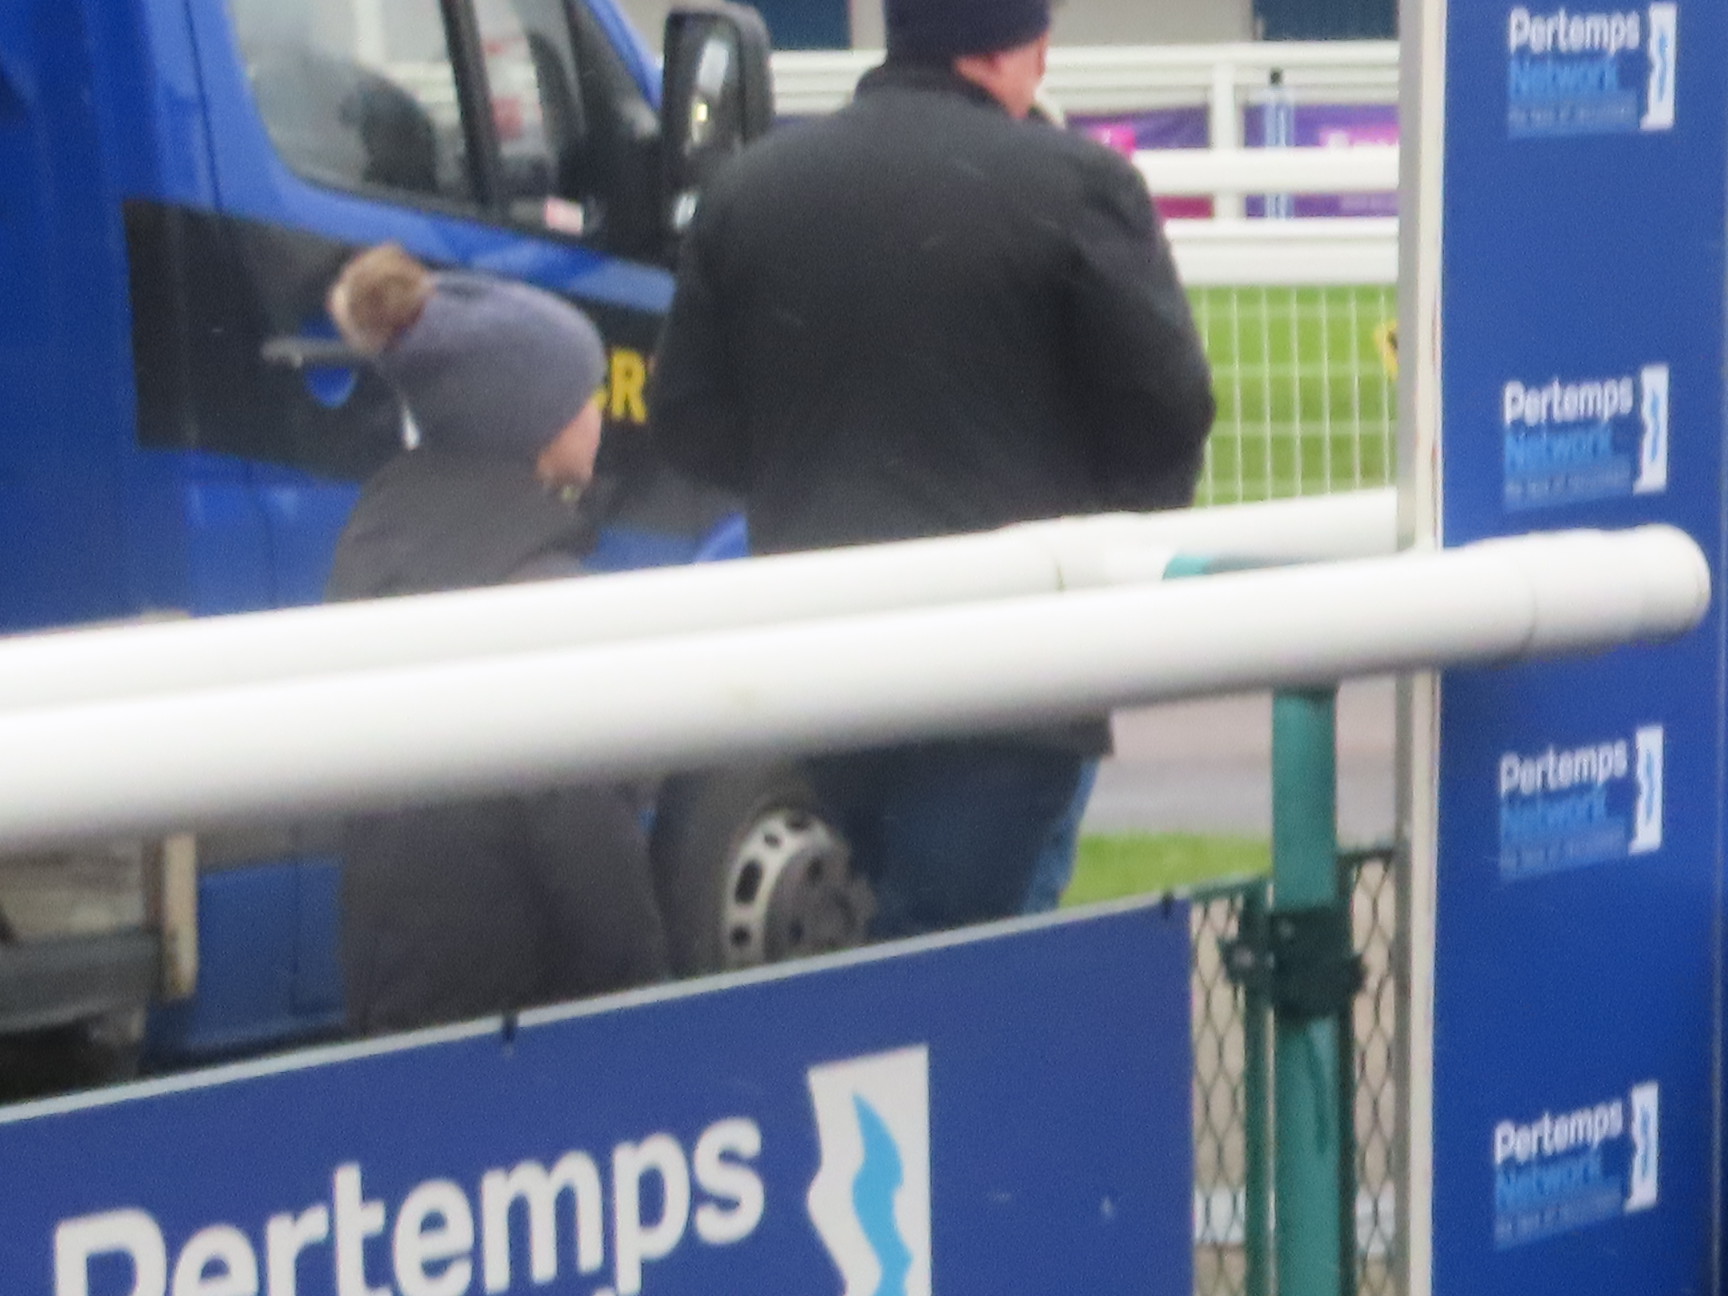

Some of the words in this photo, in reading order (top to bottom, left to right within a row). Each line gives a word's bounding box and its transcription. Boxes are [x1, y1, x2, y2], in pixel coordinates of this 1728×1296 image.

[1510, 7, 1640, 56] Pertemps
[1504, 375, 1634, 425] Pertemps
[1500, 740, 1628, 795] Pertemps
[1494, 1099, 1623, 1164] Pertemps
